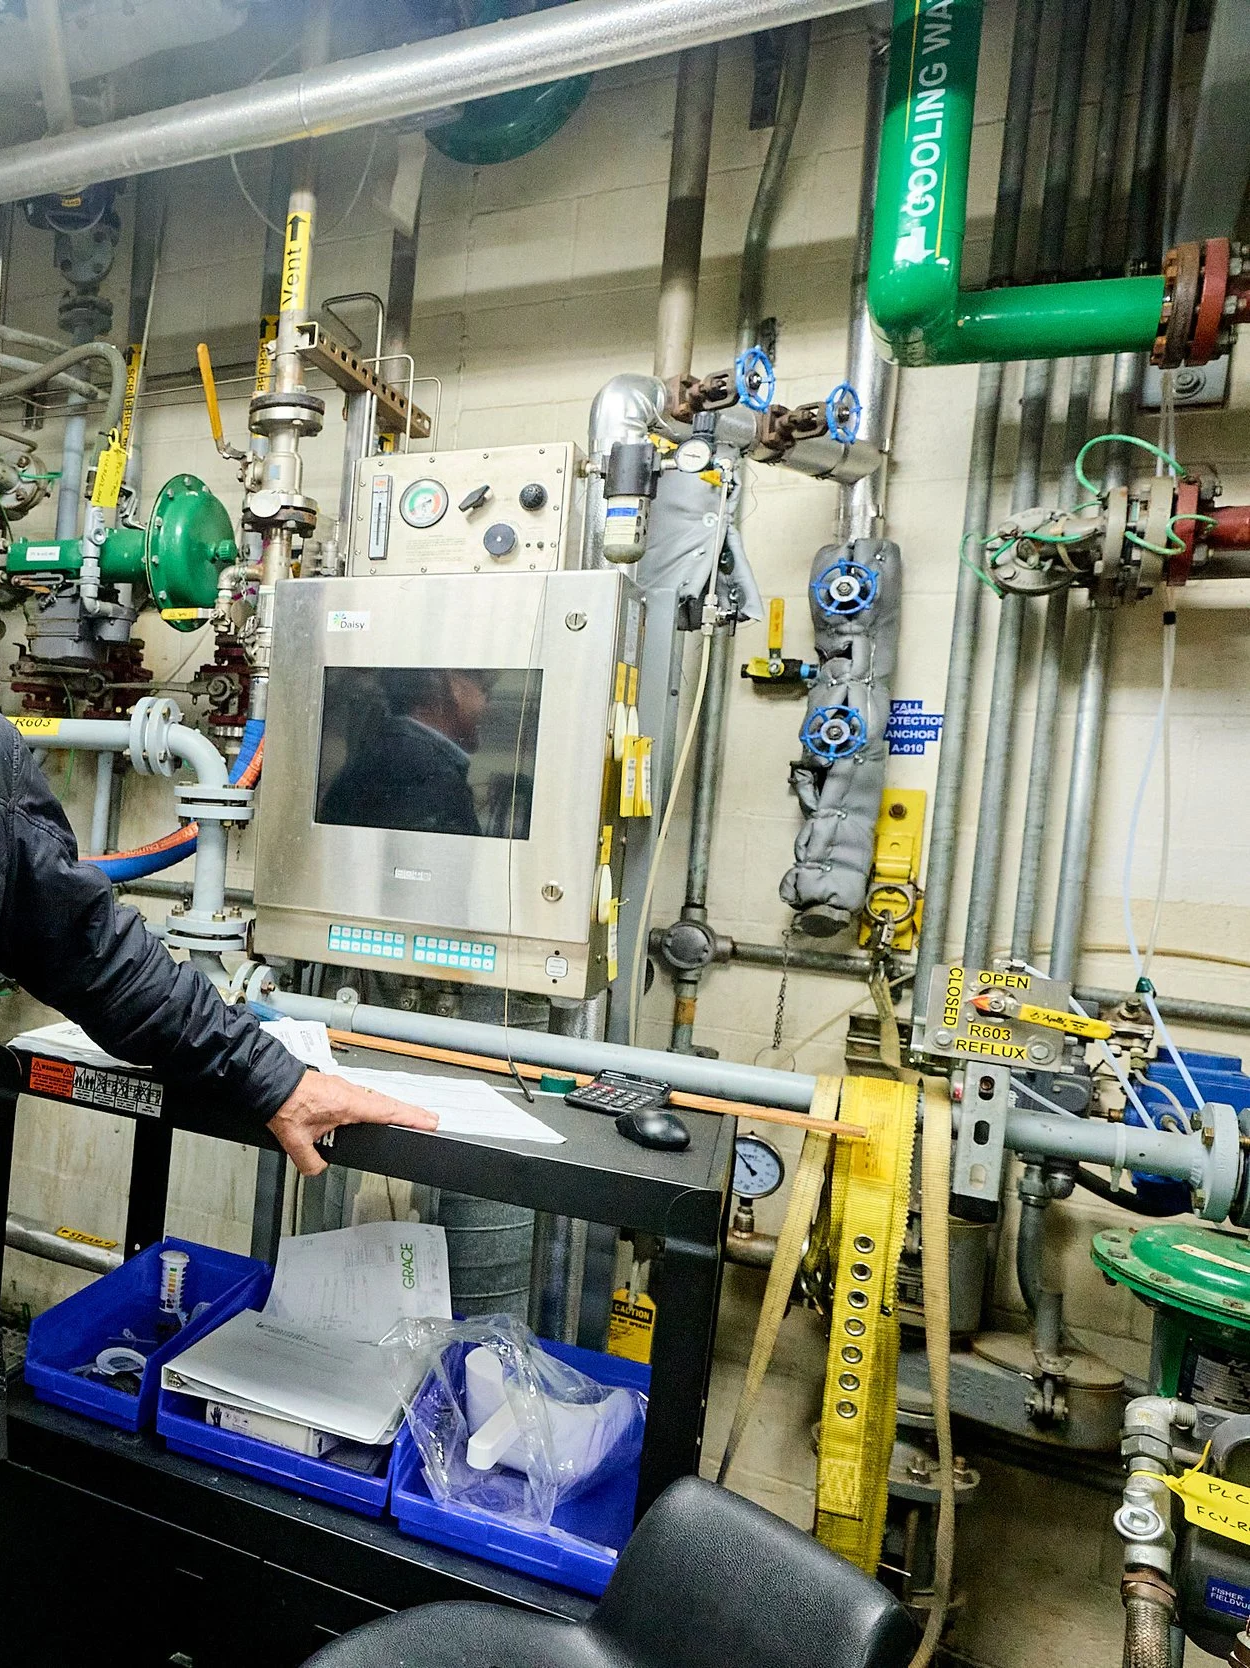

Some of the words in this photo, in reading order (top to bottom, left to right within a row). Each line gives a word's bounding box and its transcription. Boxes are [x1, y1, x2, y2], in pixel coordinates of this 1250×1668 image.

[922, 0, 953, 55] WA
[906, 62, 948, 217] COOLING
[282, 246, 302, 306] Vent
[340, 620, 365, 631] Daisy
[14, 717, 52, 728] R603
[889, 716, 944, 726] OTECTION
[885, 729, 937, 740] ANCHOR
[891, 743, 924, 753] A-010
[978, 972, 1030, 989] OPEN
[943, 967, 964, 1026] CLOSED
[969, 1025, 1012, 1041] R603
[956, 1039, 1026, 1060] REFLUX
[401, 1242, 415, 1290] GRACE
[614, 1303, 650, 1321] CAUTION
[1208, 1483, 1250, 1505] PLC
[1196, 1505, 1250, 1532] FCV_R
[1211, 1586, 1245, 1601] FISHER
